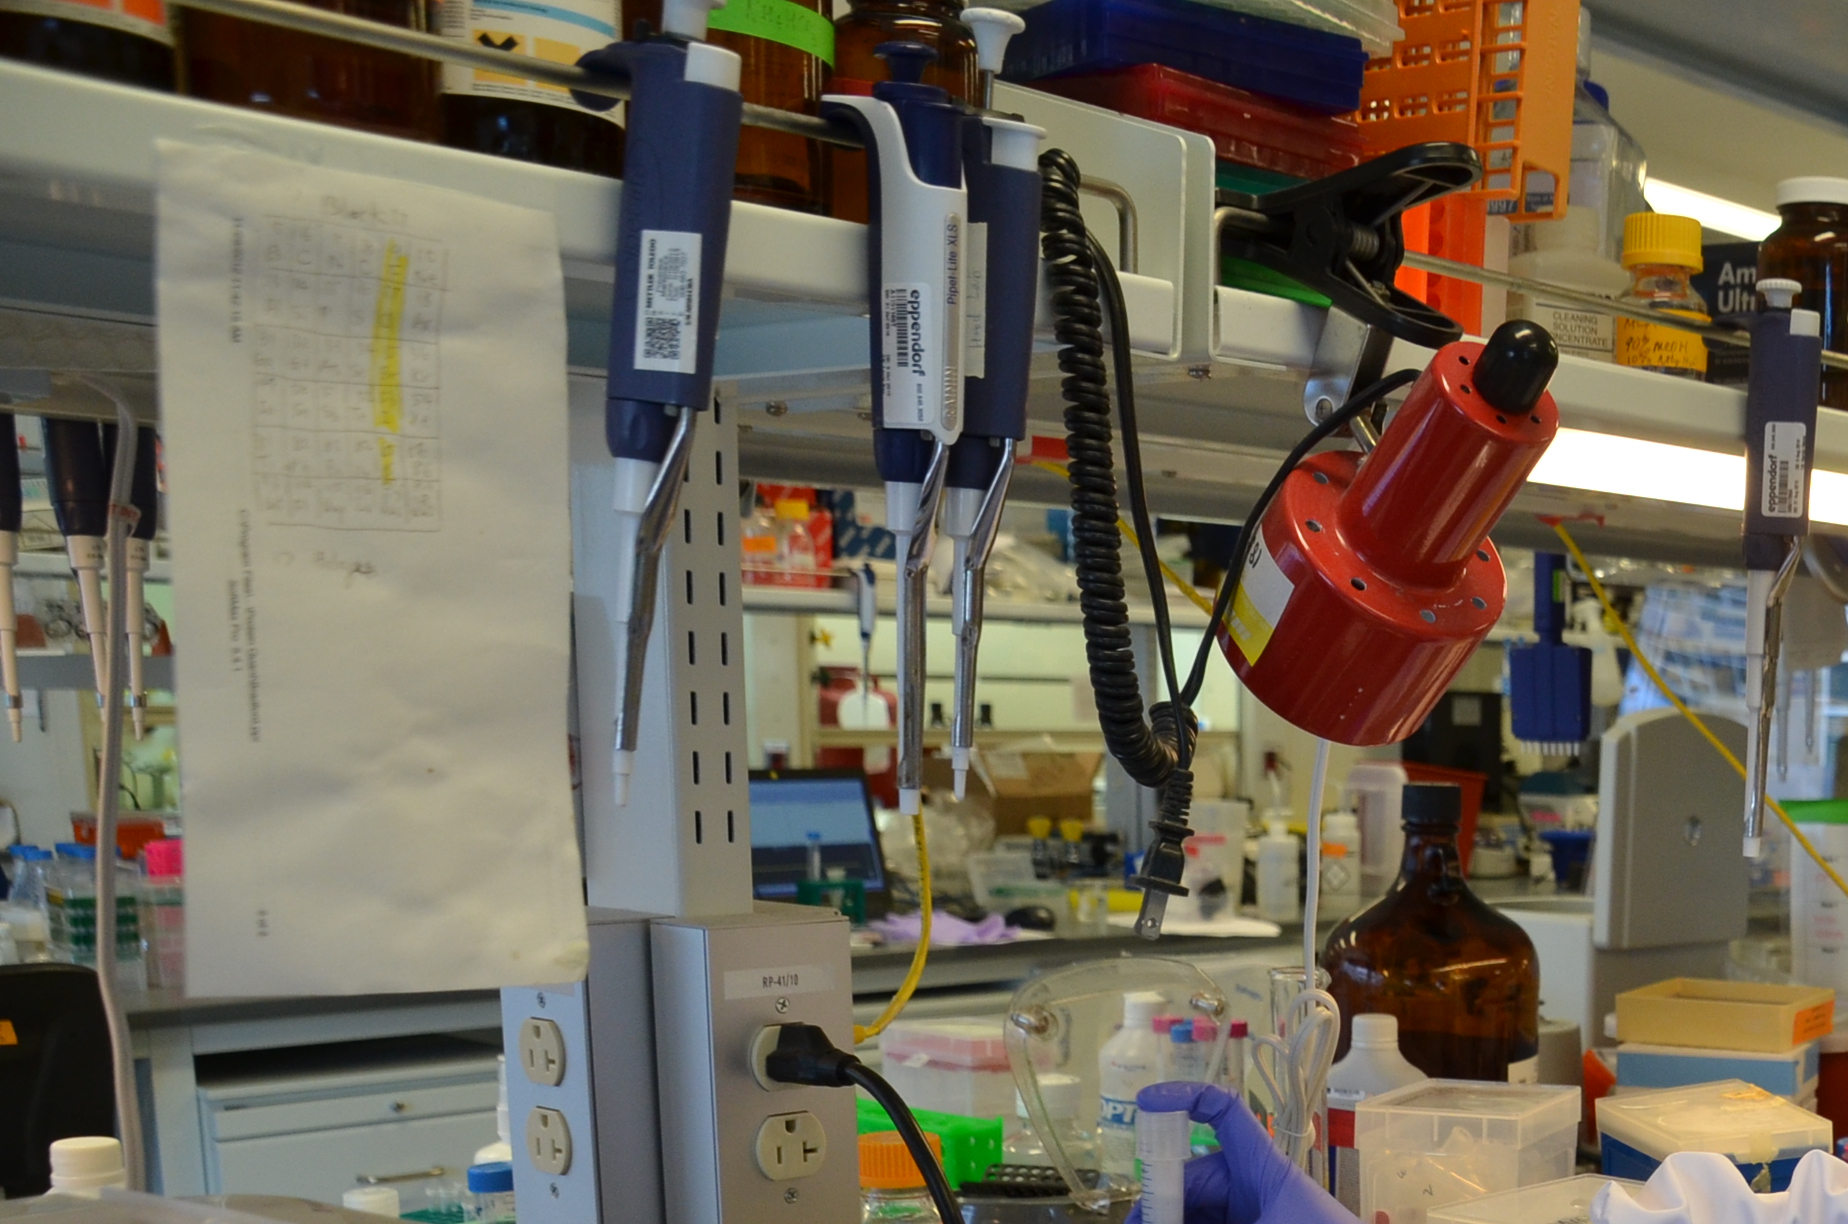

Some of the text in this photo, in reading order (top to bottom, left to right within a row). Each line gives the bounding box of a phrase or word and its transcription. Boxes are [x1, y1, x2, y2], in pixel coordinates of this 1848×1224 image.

[946, 223, 959, 306] Pipet-Lite XLS
[1717, 261, 1757, 286] Am
[1552, 311, 1598, 325] CLEANING
[1552, 322, 1598, 335] SOLUTION
[907, 289, 926, 377] eppendorf
[1551, 331, 1608, 348] NCENTRATE
[1767, 453, 1779, 513] eppendorf
[762, 973, 799, 988] RP-41/10
